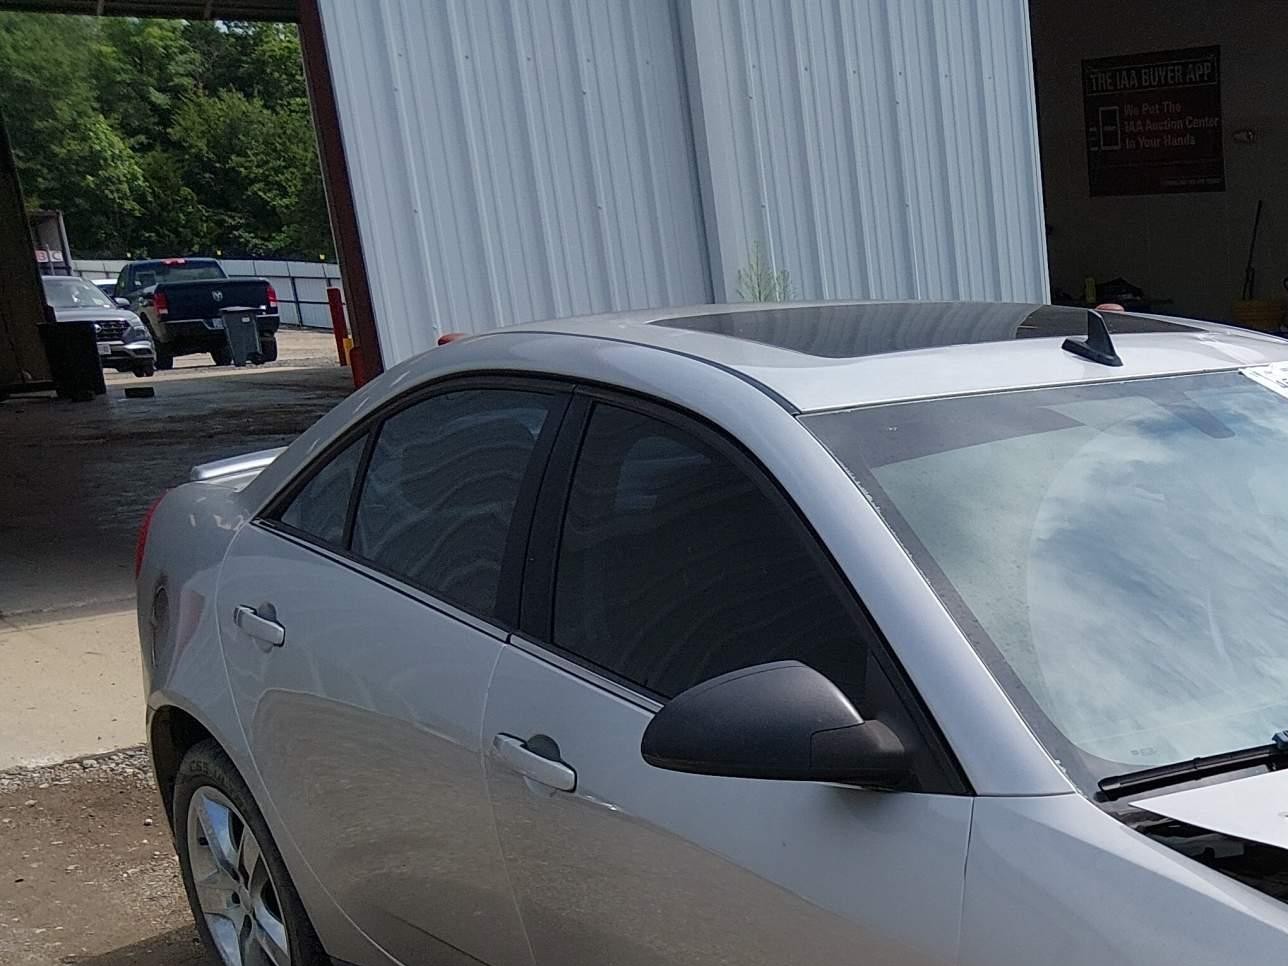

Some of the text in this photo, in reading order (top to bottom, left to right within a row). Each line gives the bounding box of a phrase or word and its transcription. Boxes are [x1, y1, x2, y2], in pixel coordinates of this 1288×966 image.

[1090, 62, 1212, 91] THE IAA BUYER APP
[1145, 117, 1184, 131] Auction
[1185, 115, 1219, 129] Center
[1138, 134, 1161, 149] Your
[1163, 132, 1196, 146] Hands
